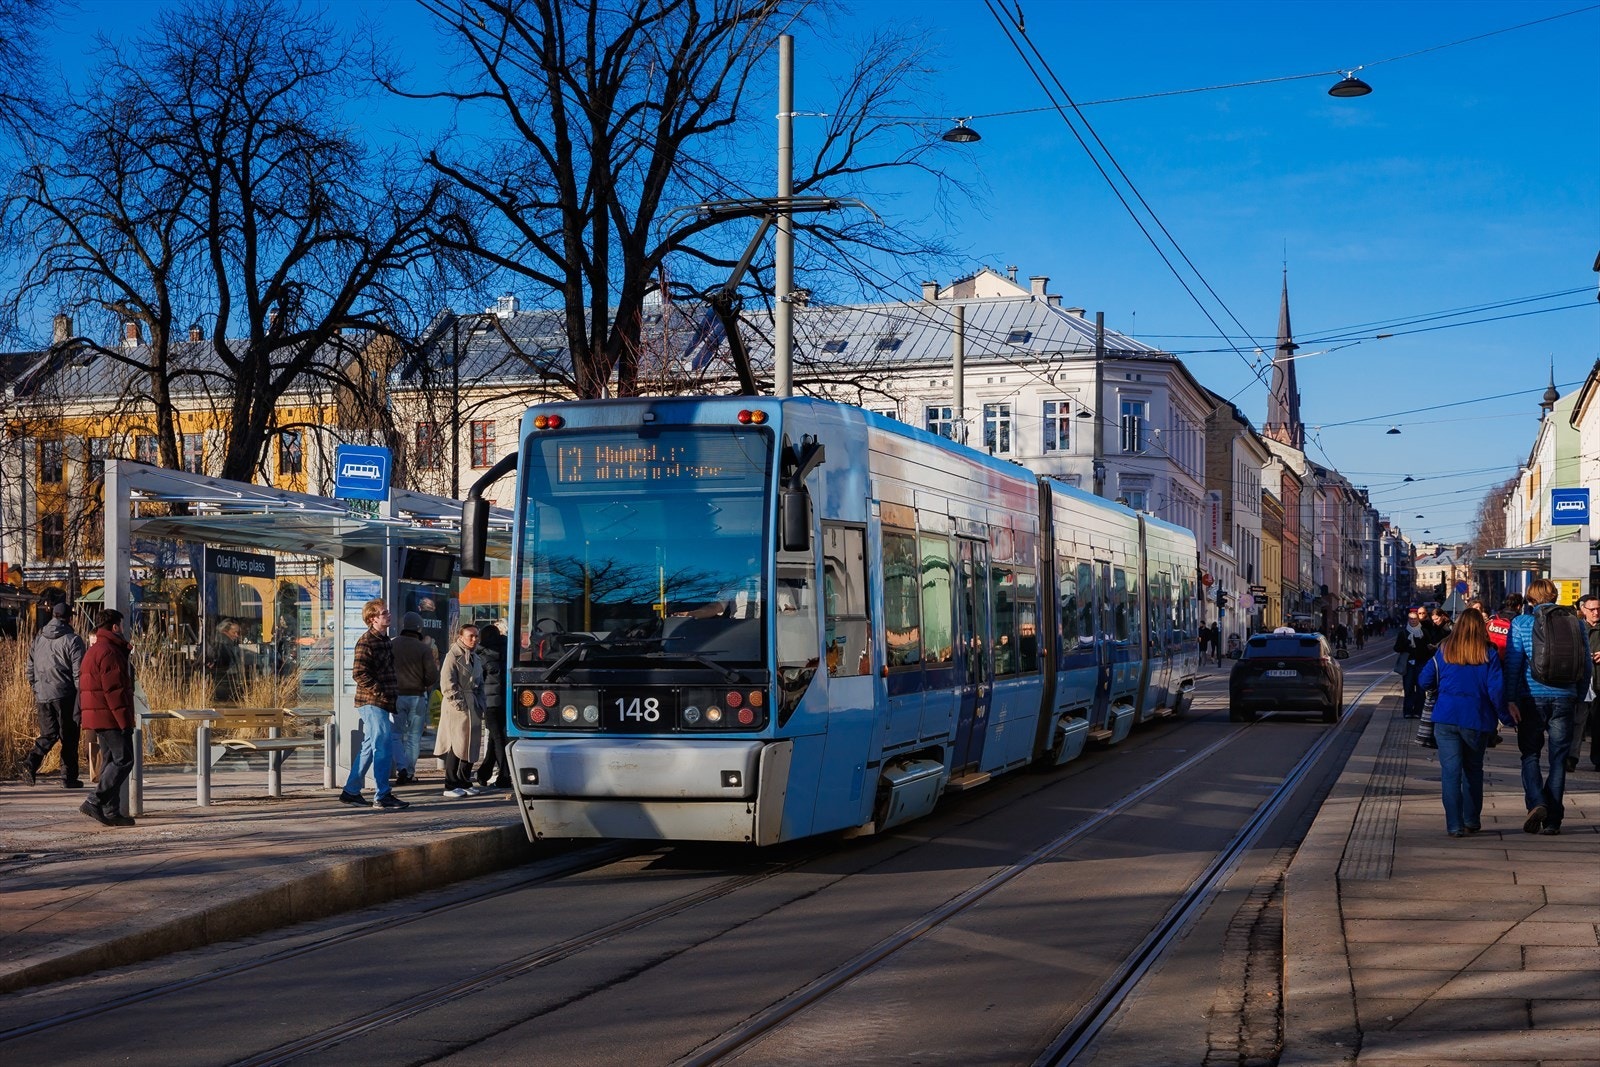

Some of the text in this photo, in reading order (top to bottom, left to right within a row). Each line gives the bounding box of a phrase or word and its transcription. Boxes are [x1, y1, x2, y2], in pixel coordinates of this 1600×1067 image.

[216, 554, 231, 568] Olaf
[232, 556, 248, 572] Ryes
[249, 559, 266, 573] plass
[615, 697, 660, 722] 148
